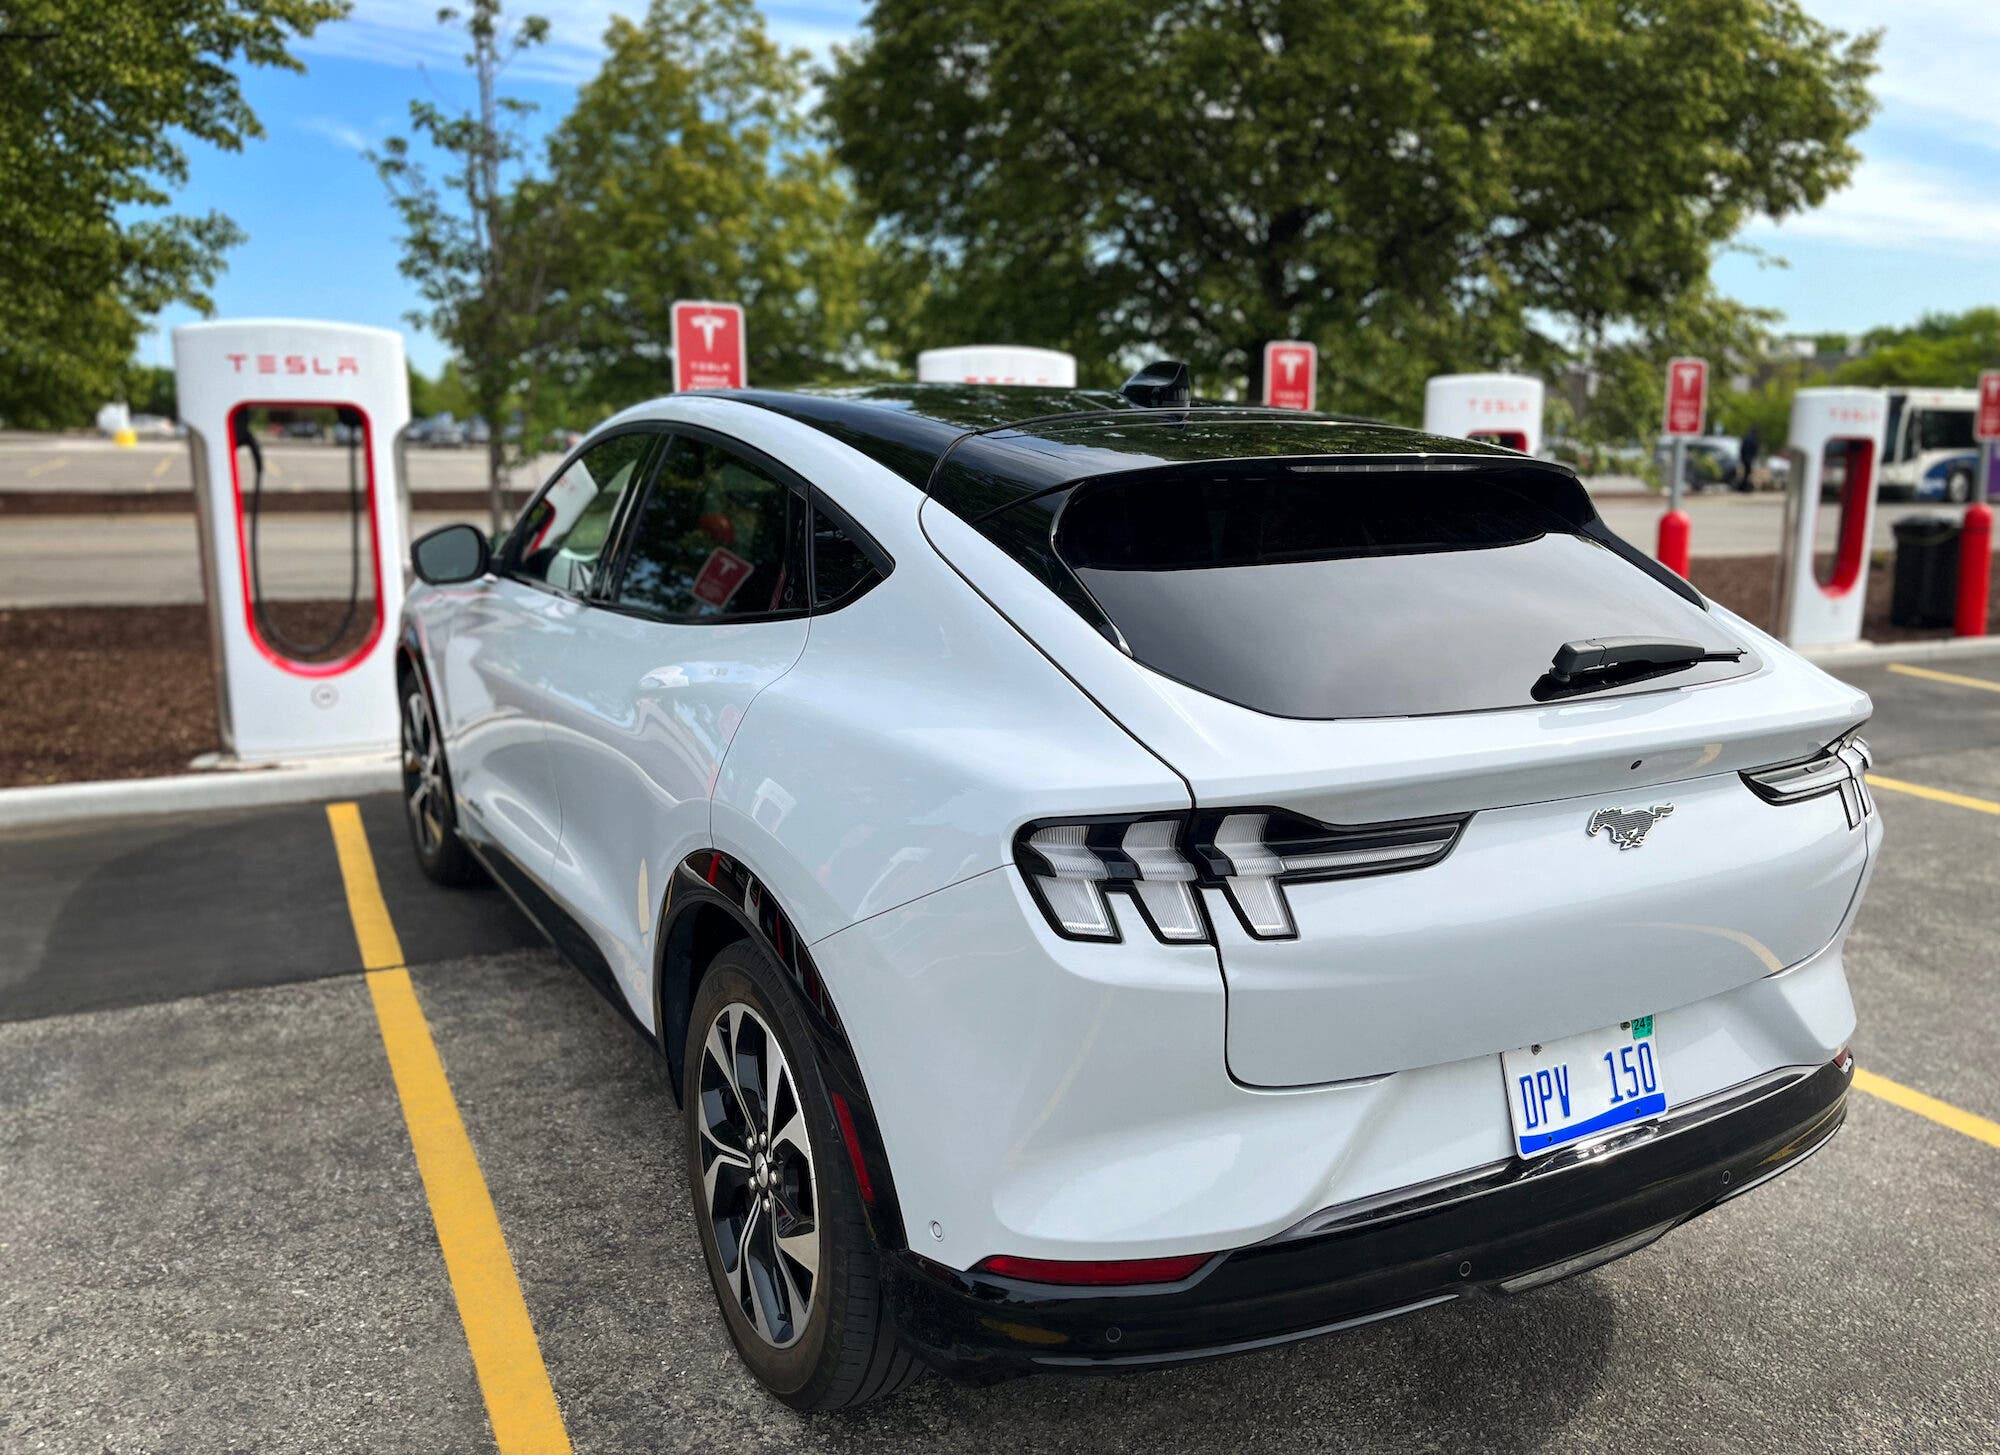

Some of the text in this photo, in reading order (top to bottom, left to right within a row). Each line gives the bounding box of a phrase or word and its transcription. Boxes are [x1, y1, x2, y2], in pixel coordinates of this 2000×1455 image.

[224, 353, 359, 375] TESLA
[1467, 397, 1529, 413] TESLA
[1519, 1041, 1657, 1130] DPV 150
